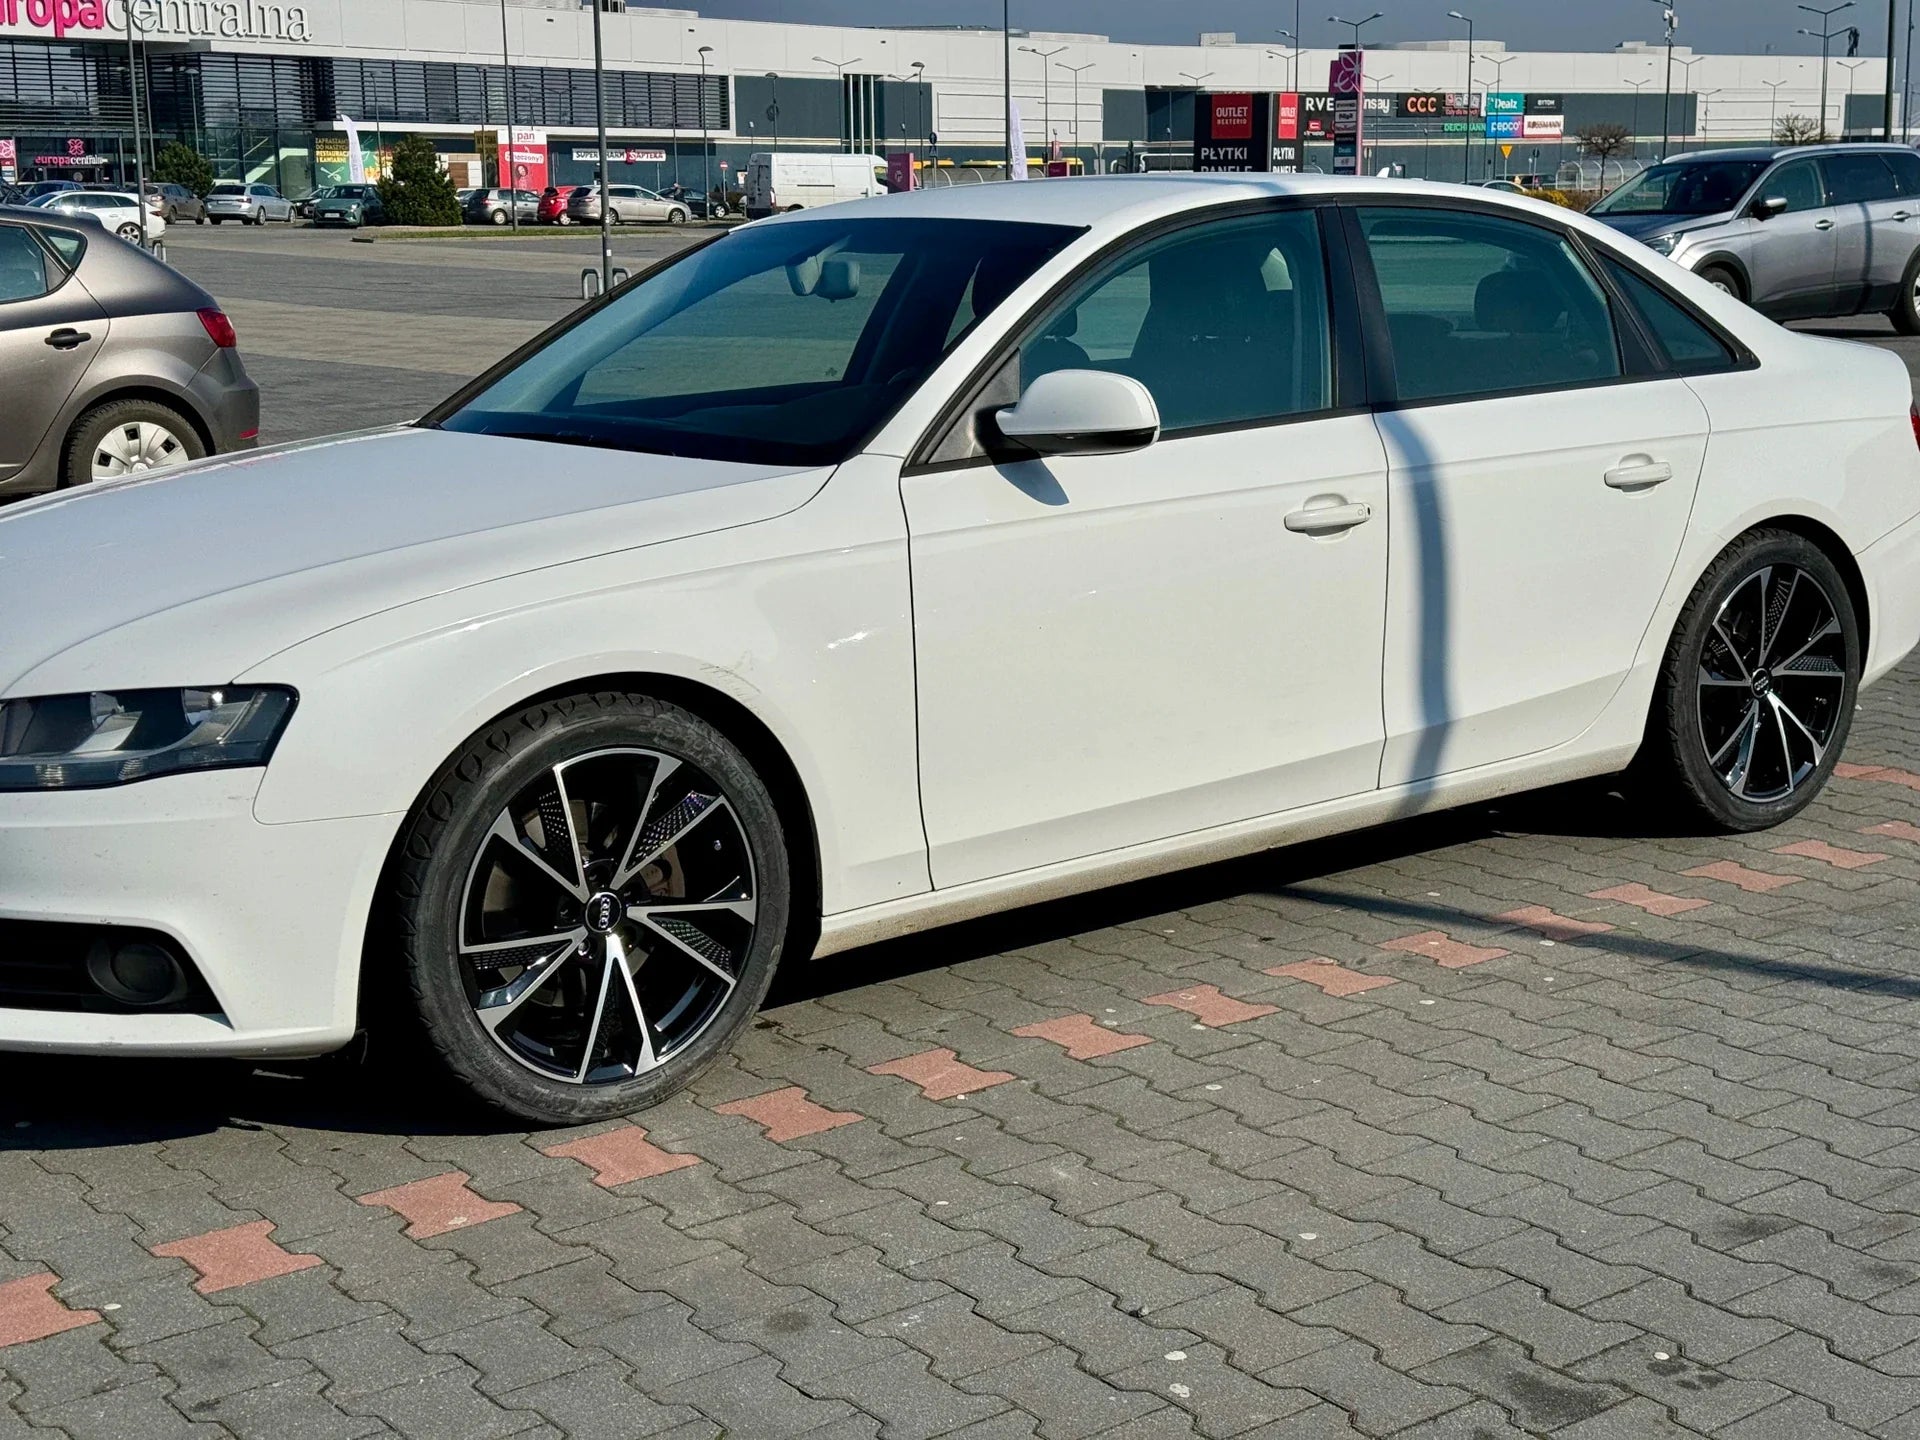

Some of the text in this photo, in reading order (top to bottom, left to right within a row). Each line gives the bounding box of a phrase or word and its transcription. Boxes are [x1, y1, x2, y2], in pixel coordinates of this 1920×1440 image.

[1363, 97, 1390, 113] nsay
[1407, 97, 1437, 112] CCC
[1495, 98, 1518, 109] Dealz
[1216, 107, 1248, 117] OUTLET
[1443, 122, 1486, 132] DEICHANN
[1490, 121, 1519, 133] pepco
[1201, 147, 1248, 160] PŁYTKI
[1273, 147, 1295, 160] PŁYTKI
